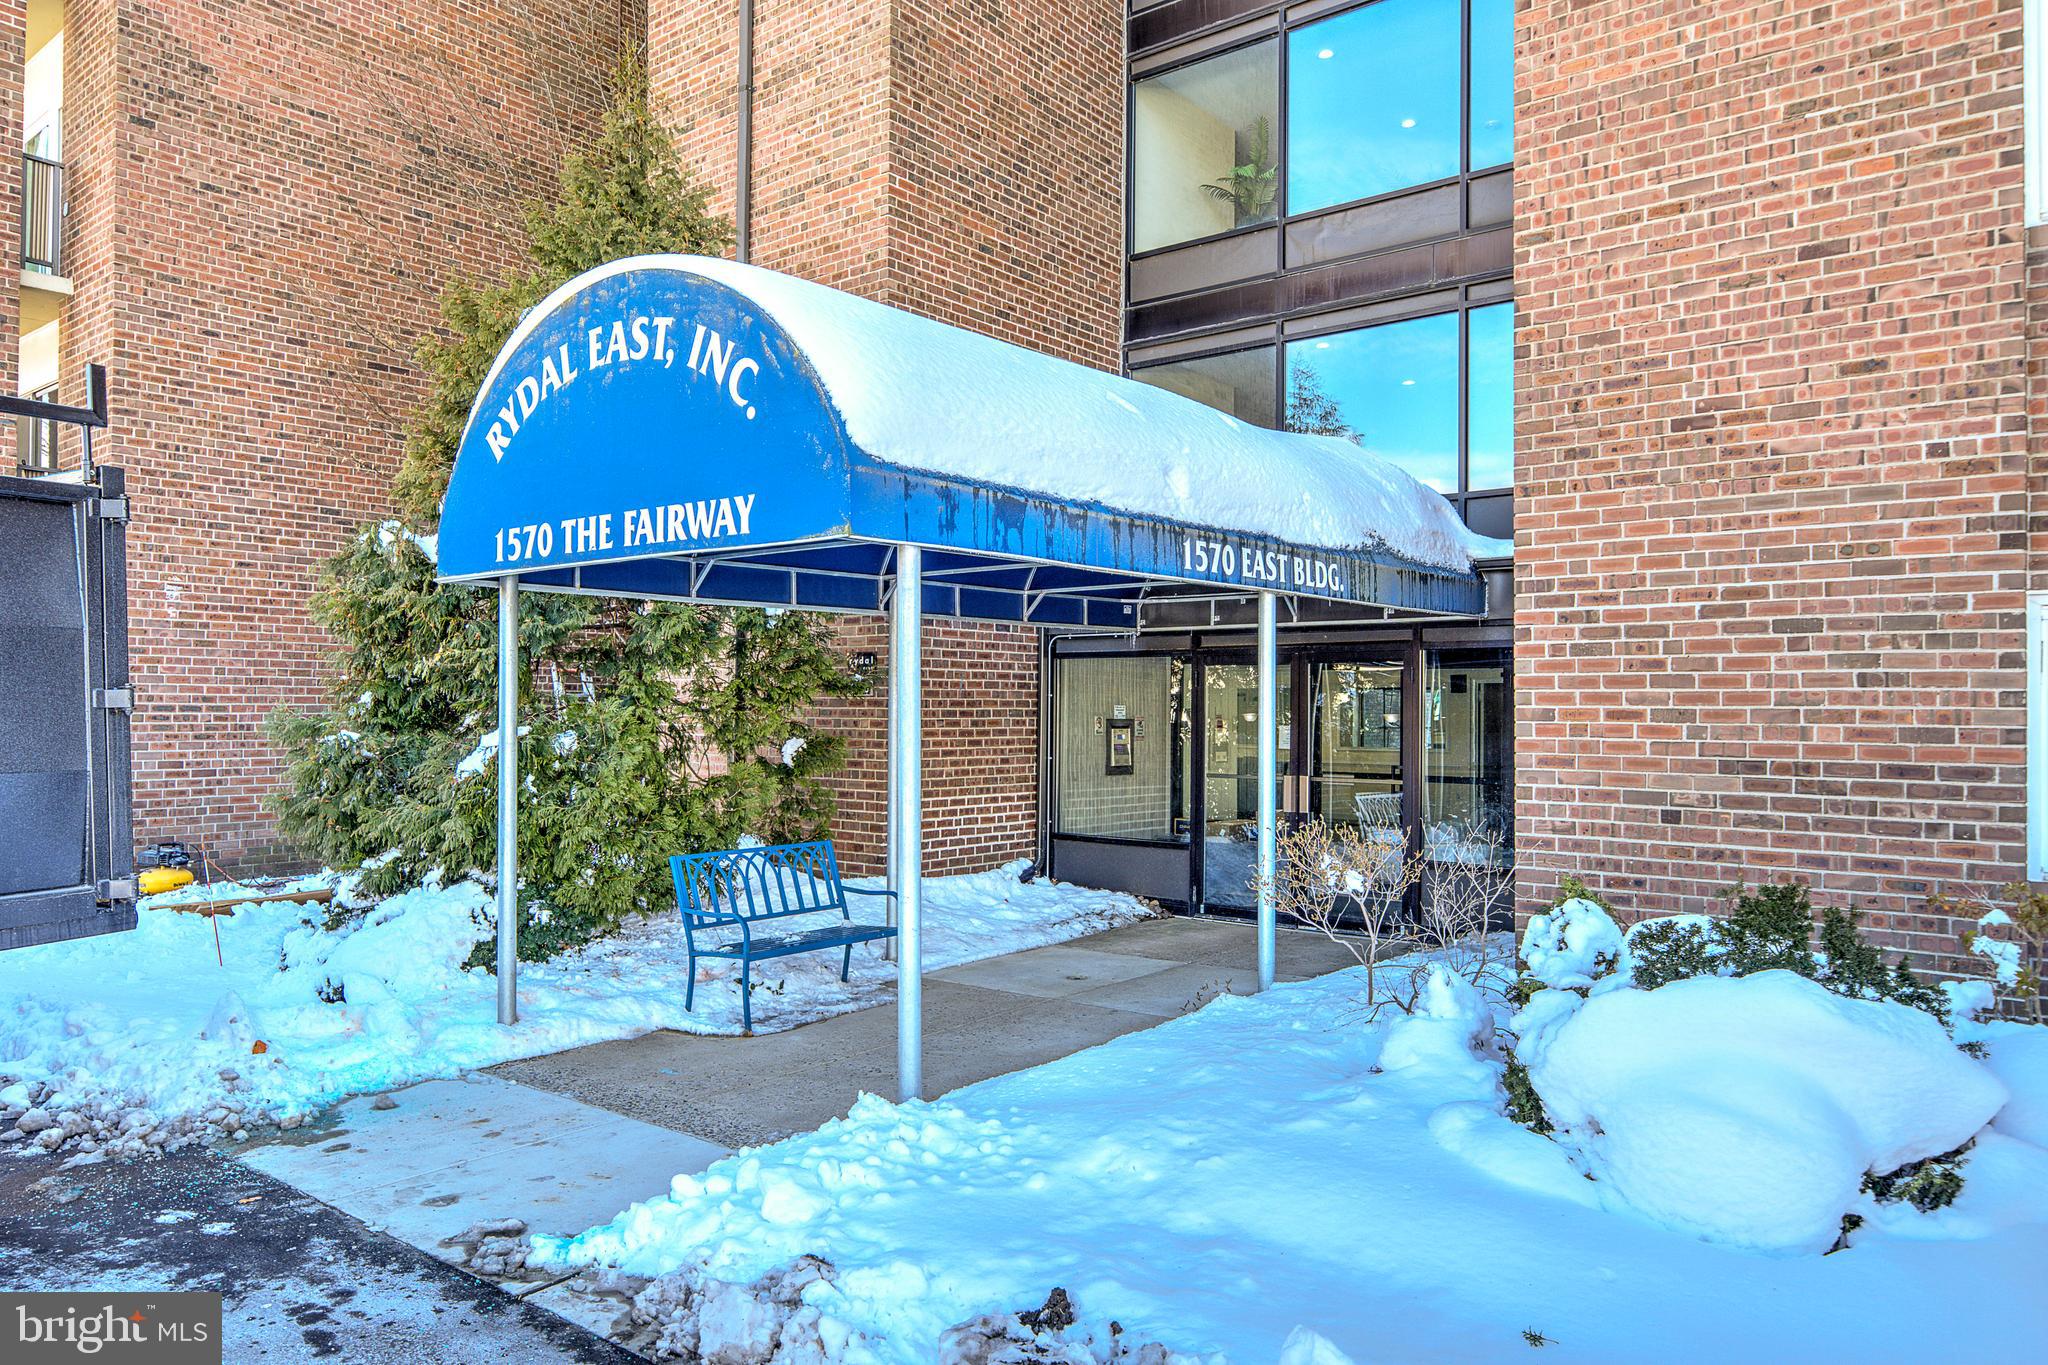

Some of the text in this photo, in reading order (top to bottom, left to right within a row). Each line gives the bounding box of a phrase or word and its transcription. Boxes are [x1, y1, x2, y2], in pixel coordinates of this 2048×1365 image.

[485, 316, 760, 464] RYDAL EAST, INC.
[495, 493, 756, 562] 1570 THE FAIRWAY
[1183, 537, 1345, 592] 1570 EAST BLDG.
